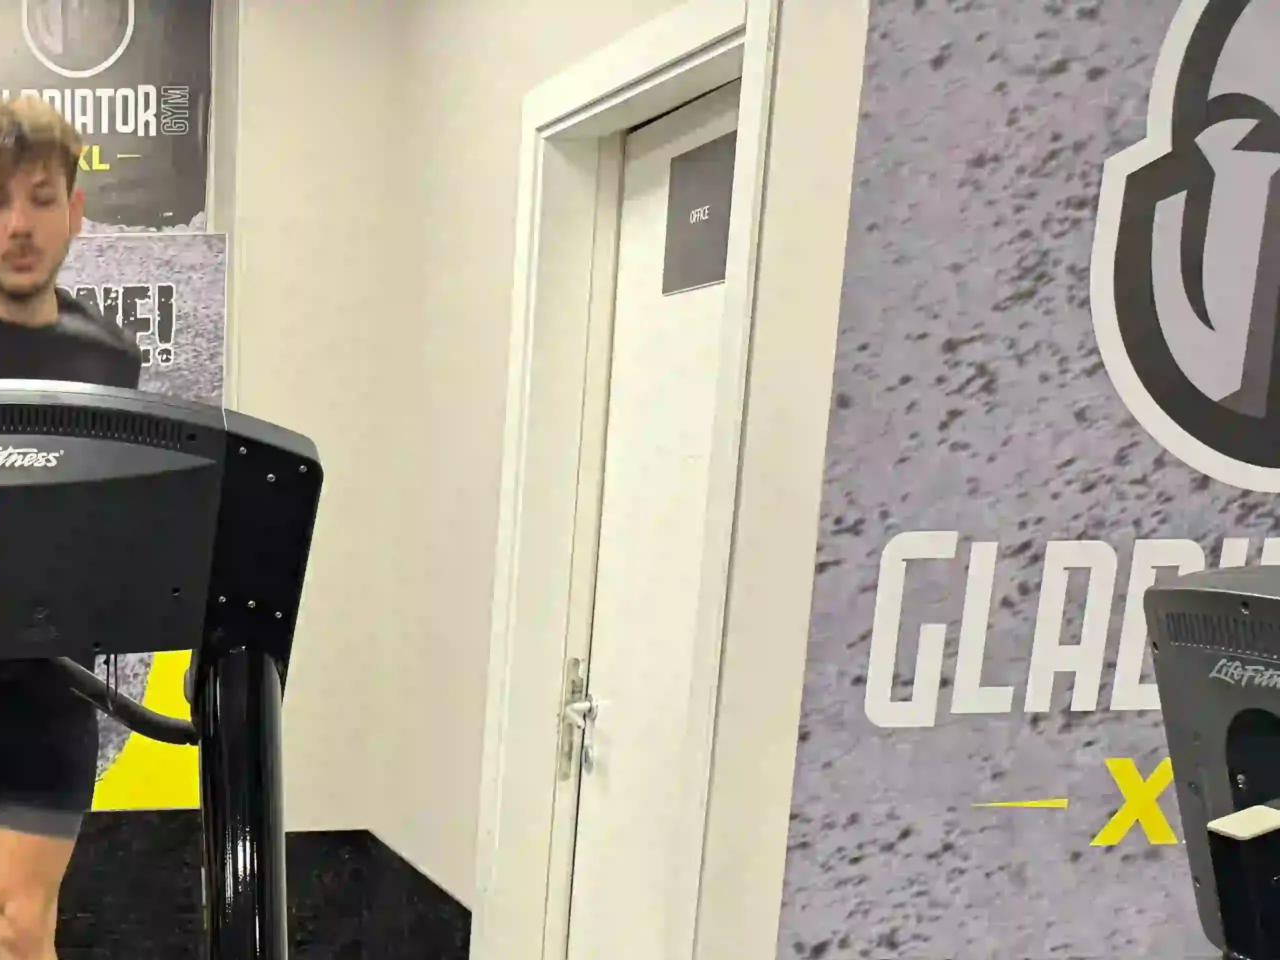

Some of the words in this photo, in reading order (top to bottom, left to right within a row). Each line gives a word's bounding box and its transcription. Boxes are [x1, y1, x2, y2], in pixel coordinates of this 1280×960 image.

[161, 85, 189, 136] GYM
[689, 205, 711, 224] OFFICE
[864, 531, 1280, 727] GLAD
